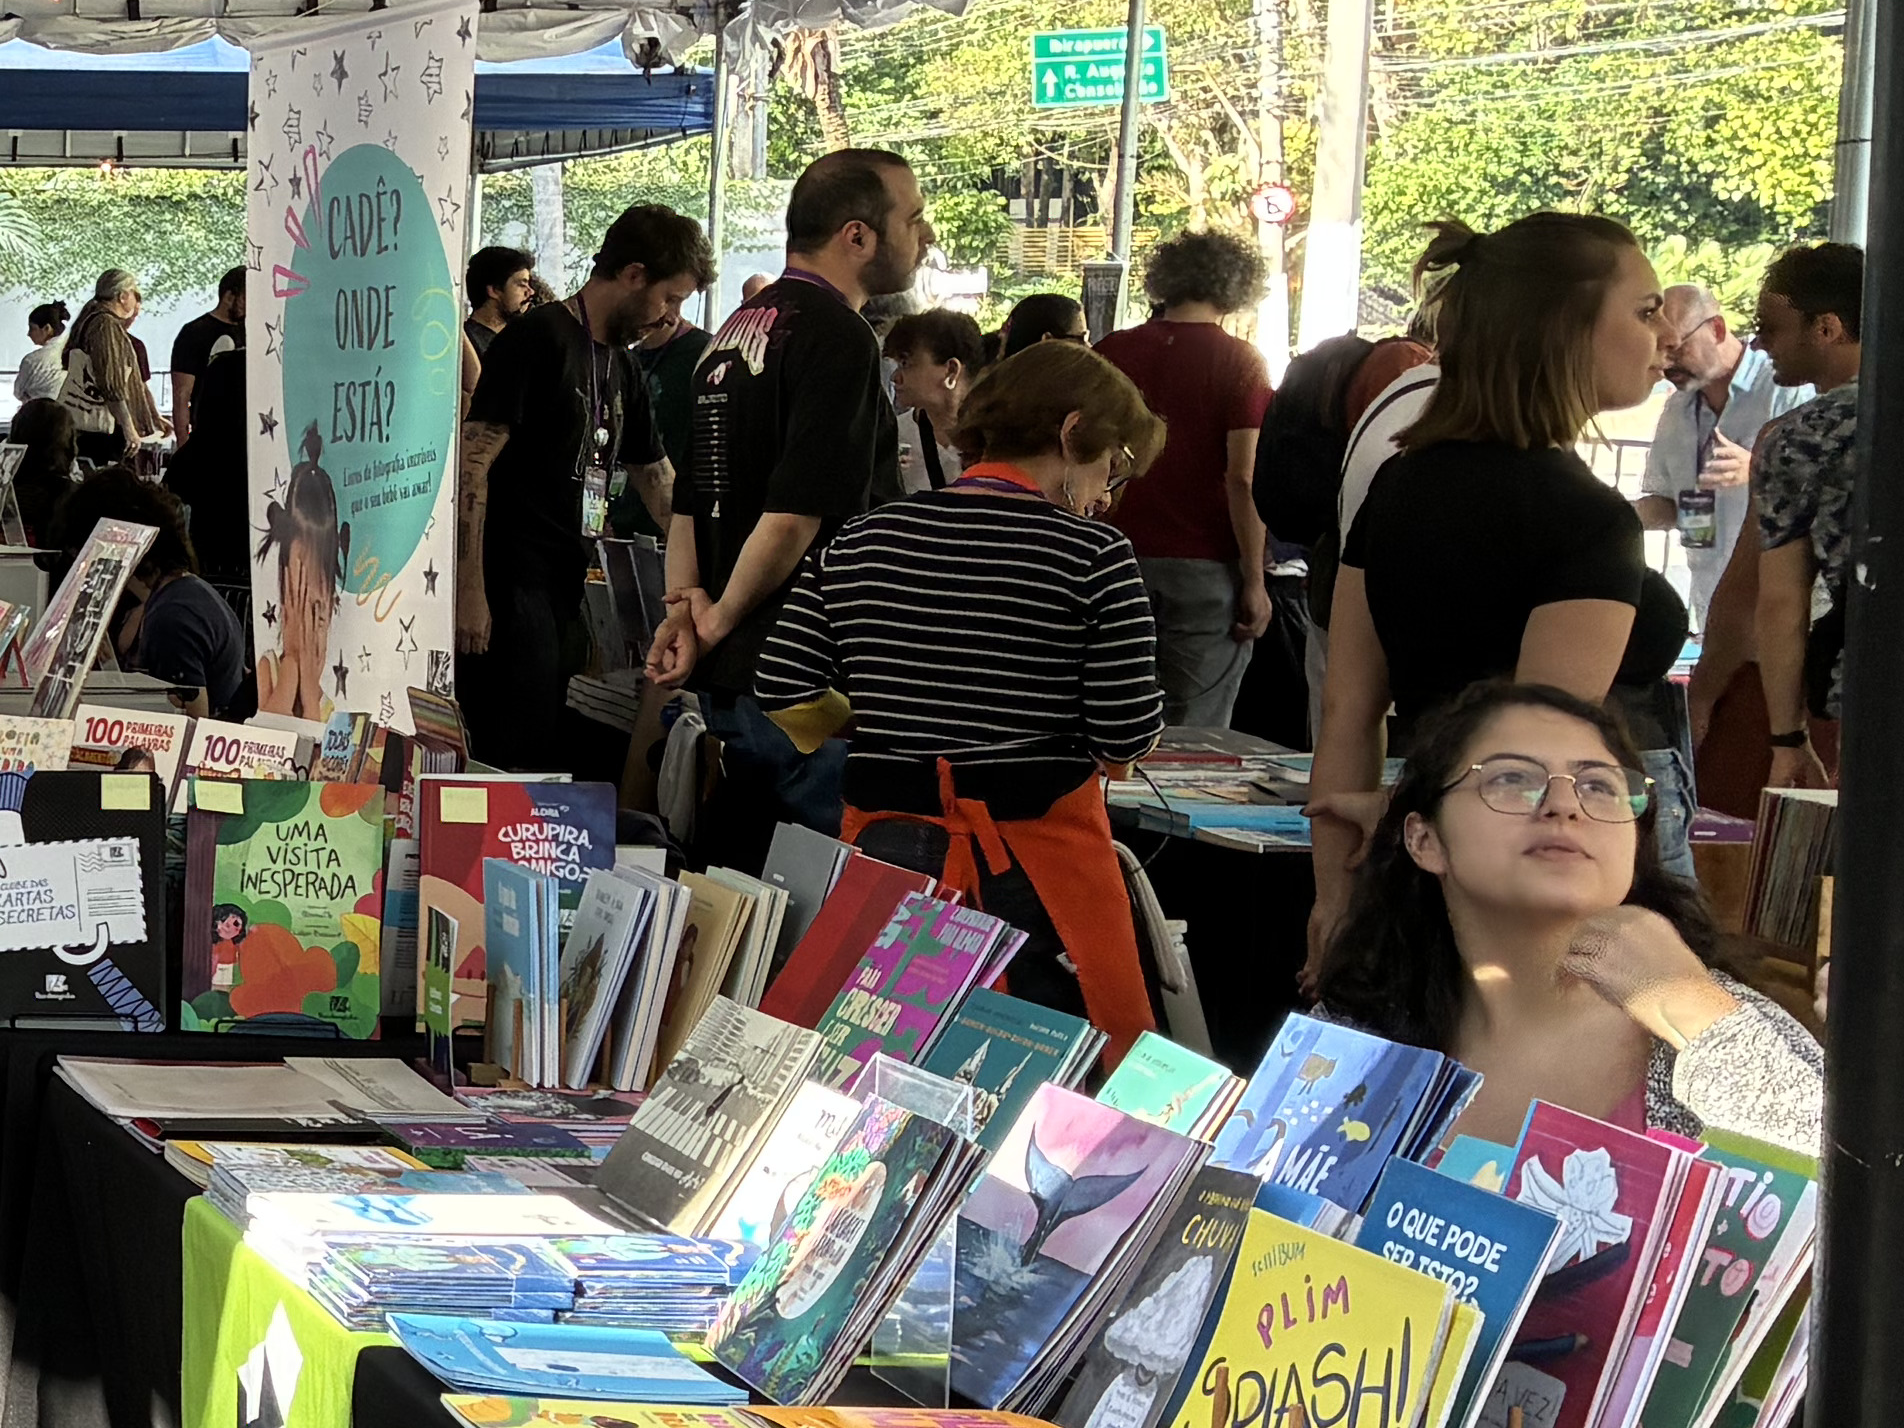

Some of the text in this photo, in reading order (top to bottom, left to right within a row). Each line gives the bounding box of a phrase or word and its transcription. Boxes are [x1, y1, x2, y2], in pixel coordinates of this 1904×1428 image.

[328, 175, 402, 260] CADÊ?
[335, 285, 397, 351] ONDE
[330, 365, 396, 444] ESTÁ?
[406, 442, 437, 468] incríveis
[399, 483, 411, 502] vai
[411, 472, 432, 500] amar!
[85, 717, 175, 746] 100 PRIMEIRAS
[123, 736, 172, 753] PALAVRAS
[205, 734, 287, 766] 100 PRIMEIRAS
[276, 820, 328, 844] UMA
[497, 823, 593, 850] CURUPIRA,
[266, 843, 342, 870] VISITA
[511, 842, 581, 863] BRINCA
[28, 878, 49, 889] DAS
[241, 863, 358, 901] INESPERADA
[836, 987, 902, 1036] CRESCER
[1276, 1145, 1339, 1196] MÃE
[1386, 1202, 1507, 1272] O QUE PODE
